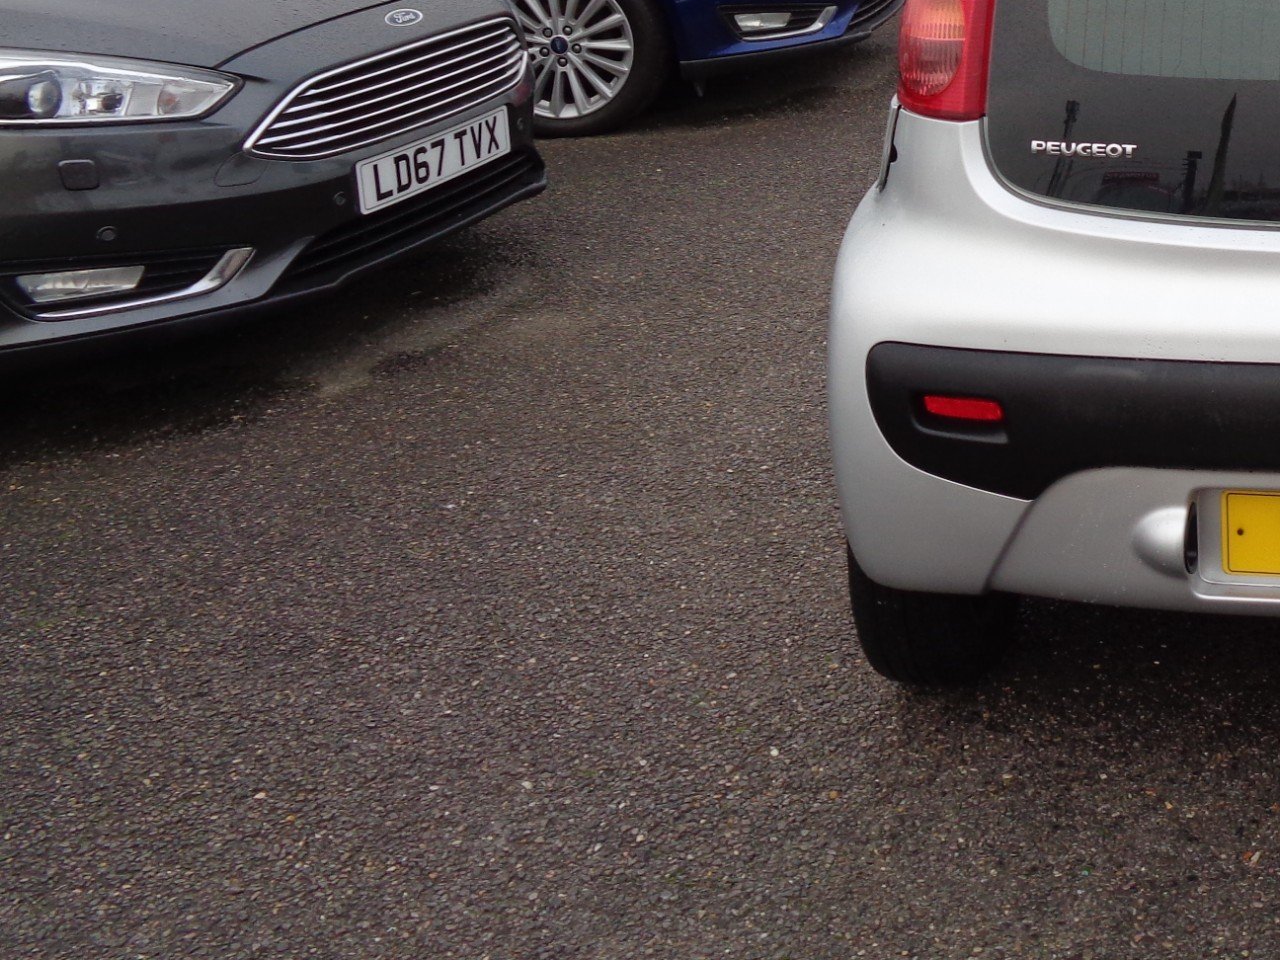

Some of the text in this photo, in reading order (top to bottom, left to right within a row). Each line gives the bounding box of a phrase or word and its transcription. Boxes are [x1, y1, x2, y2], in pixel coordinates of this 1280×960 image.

[393, 11, 416, 23] Ford
[1030, 140, 1138, 158] PEUGEOT
[373, 116, 500, 202] LD67 TVX
